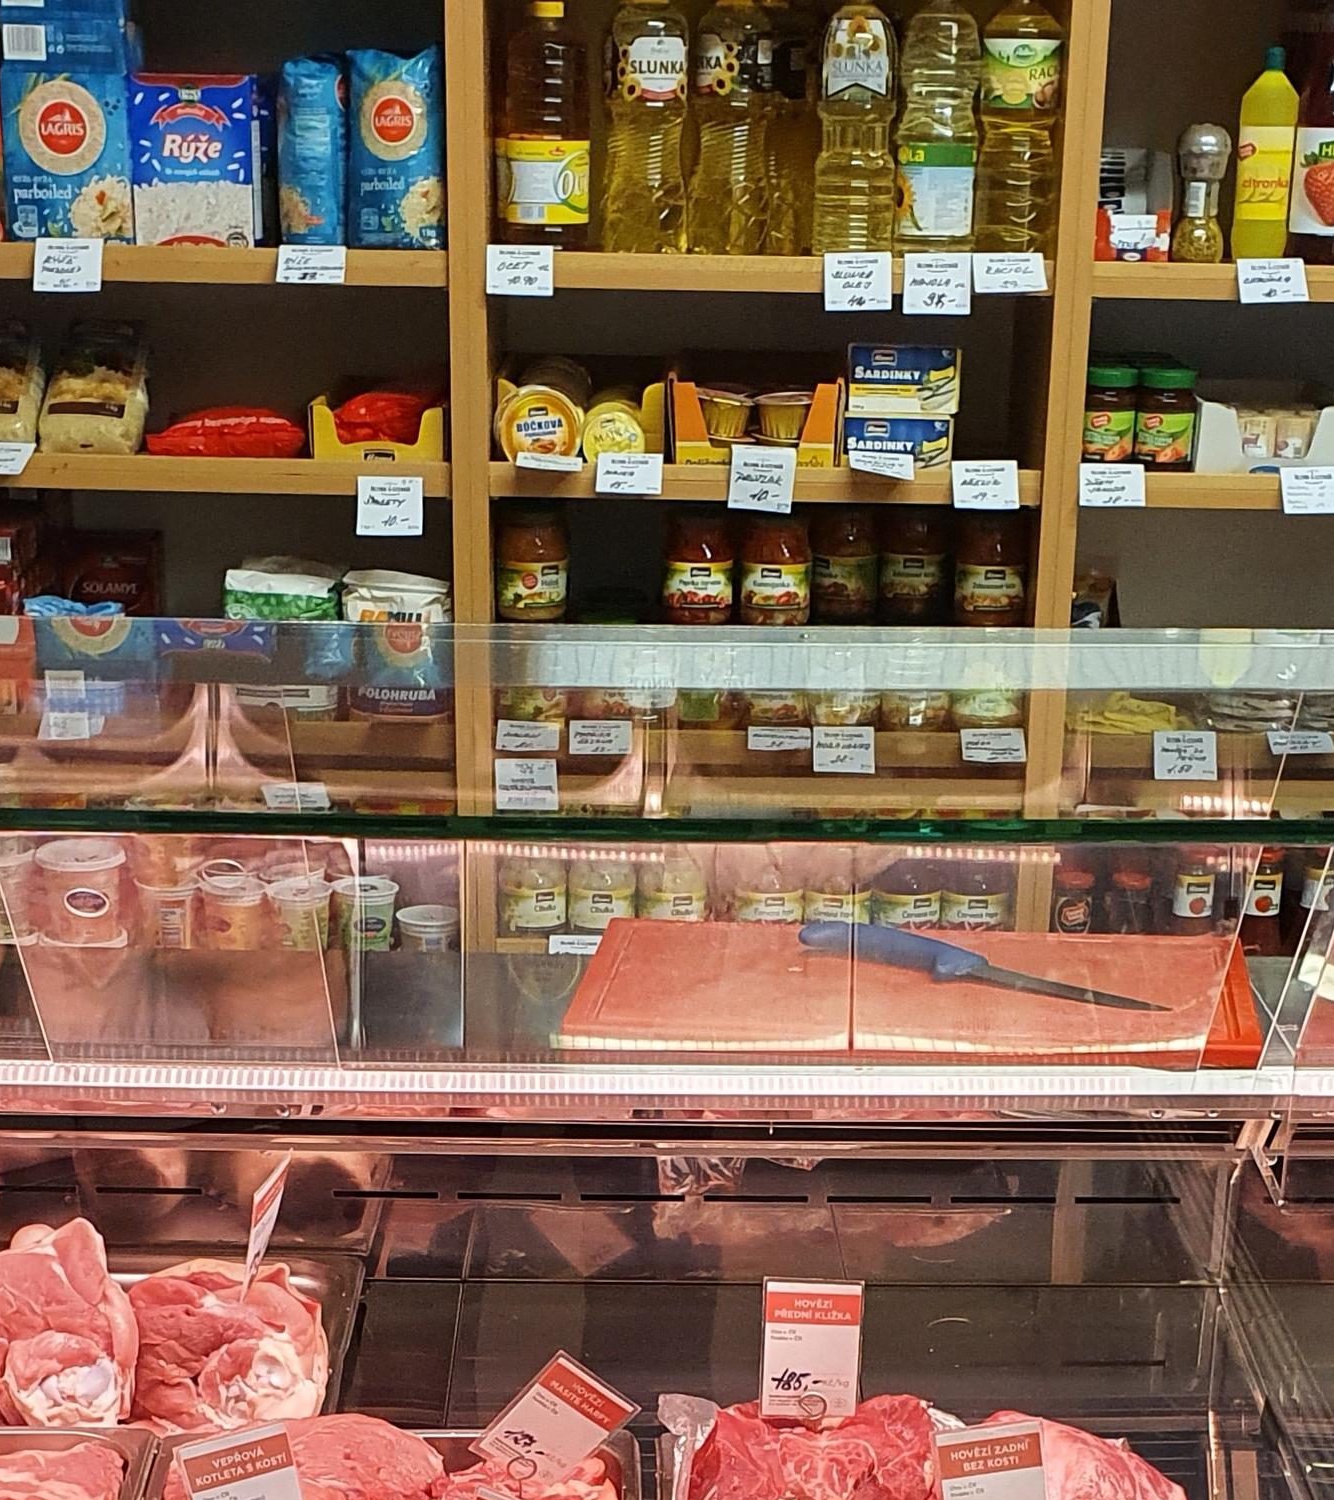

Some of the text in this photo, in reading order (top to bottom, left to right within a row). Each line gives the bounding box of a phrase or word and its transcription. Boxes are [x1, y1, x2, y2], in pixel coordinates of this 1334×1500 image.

[629, 60, 684, 76] SLUNKA
[831, 60, 884, 75] SLUNKA
[40, 121, 85, 138] LAGRIS
[375, 115, 413, 128] LAGRIS
[162, 133, 223, 163] Rýže
[359, 177, 407, 197] parboiled
[1241, 176, 1289, 189] citronka
[12, 184, 73, 206] parboiled
[497, 261, 533, 271] OCET
[853, 365, 921, 381] SARDINKY
[846, 437, 915, 452] SARDINKY
[357, 686, 437, 702] POLOHRUBA
[793, 1298, 834, 1311] HOVĚZÍ
[773, 1306, 853, 1321] PŘEDNÍ KLIŽKA
[211, 1445, 265, 1469] VEPŘOVÁ
[950, 1438, 1031, 1463] HOVĚZÍ ZADNÍ
[962, 1455, 1020, 1472] BEZ KOSTI
[195, 1466, 245, 1487] KOTLETA
